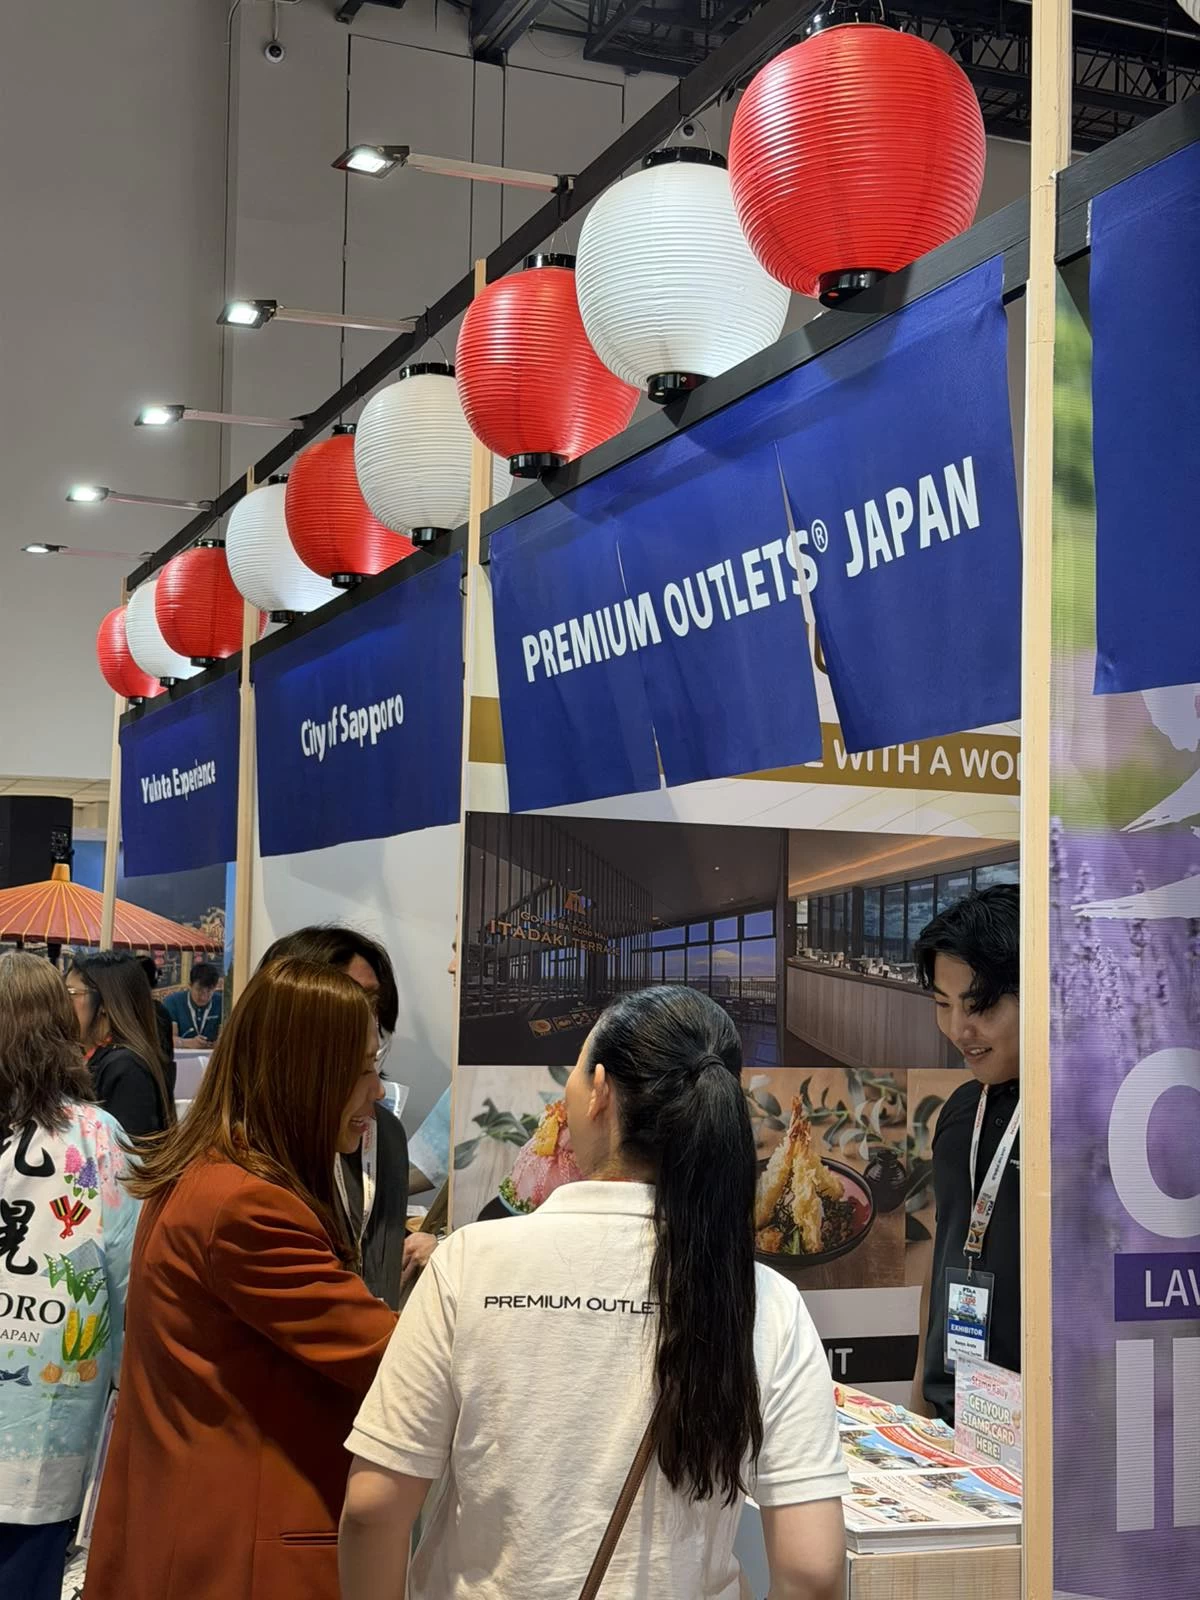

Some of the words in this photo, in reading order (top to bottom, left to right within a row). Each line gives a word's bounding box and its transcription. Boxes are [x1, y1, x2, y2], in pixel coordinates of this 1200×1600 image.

[521, 591, 662, 683] PREMIUM
[844, 455, 980, 578] JAPAN
[340, 694, 404, 748] Sapporo
[930, 746, 951, 776] A
[960, 747, 1021, 781] WO
[489, 919, 567, 947] ITADAKI
[484, 1295, 581, 1309] PREMIUM
[951, 1323, 983, 1337] EXHIBITOR
[970, 1393, 986, 1413] GET
[985, 1400, 1010, 1424] YOUR
[962, 1411, 989, 1436] STAMP
[990, 1422, 1015, 1446] CARD
